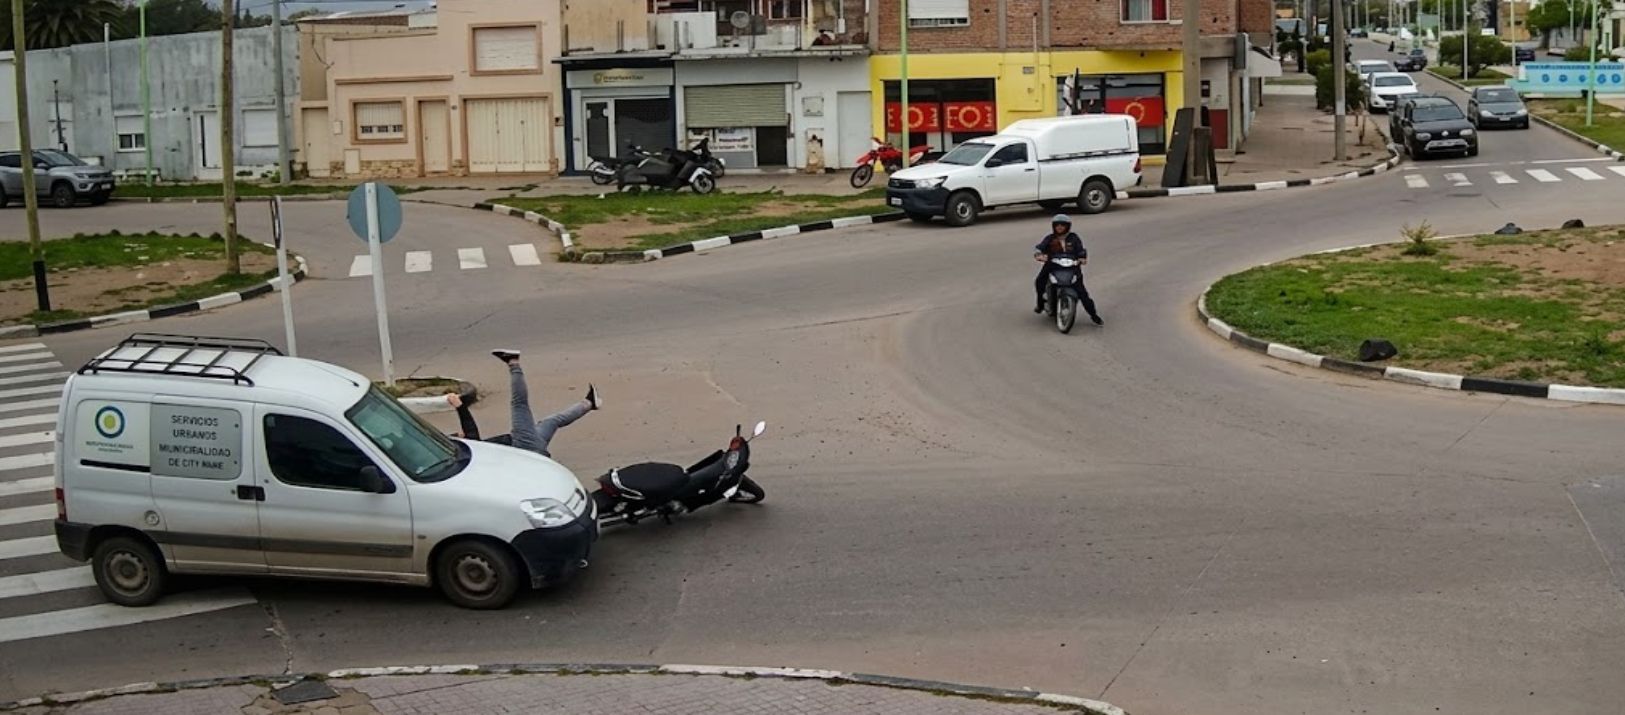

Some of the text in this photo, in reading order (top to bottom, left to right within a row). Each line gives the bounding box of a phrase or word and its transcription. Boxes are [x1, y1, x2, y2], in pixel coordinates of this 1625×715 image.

[171, 415, 219, 427] SERVICIOS
[172, 429, 217, 440] URBANOS
[168, 458, 181, 467] DE
